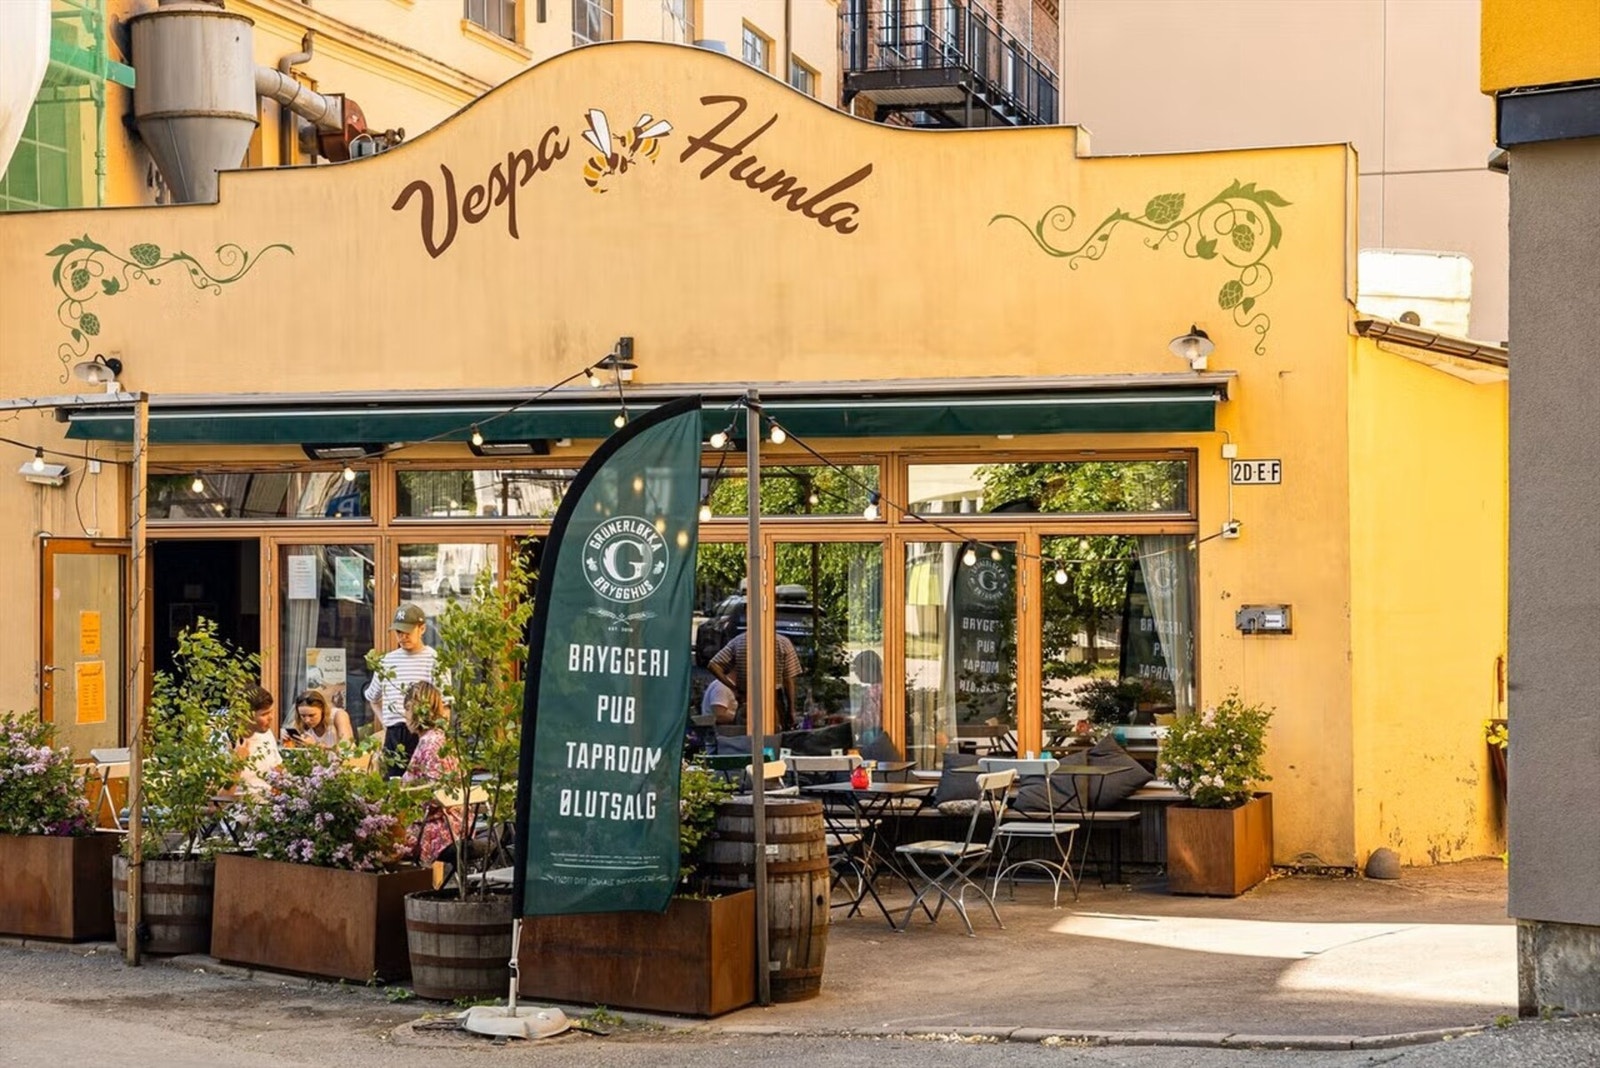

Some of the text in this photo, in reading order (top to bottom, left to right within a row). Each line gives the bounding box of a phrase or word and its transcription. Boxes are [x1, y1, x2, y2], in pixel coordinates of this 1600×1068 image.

[392, 95, 873, 259] Vespa Humla
[593, 576, 654, 600] BRYGGHUS
[568, 643, 669, 677] BRYGGERI
[596, 694, 636, 725] PUB
[565, 741, 662, 775] TAPROOM
[559, 788, 657, 821] ØLUTSALG
